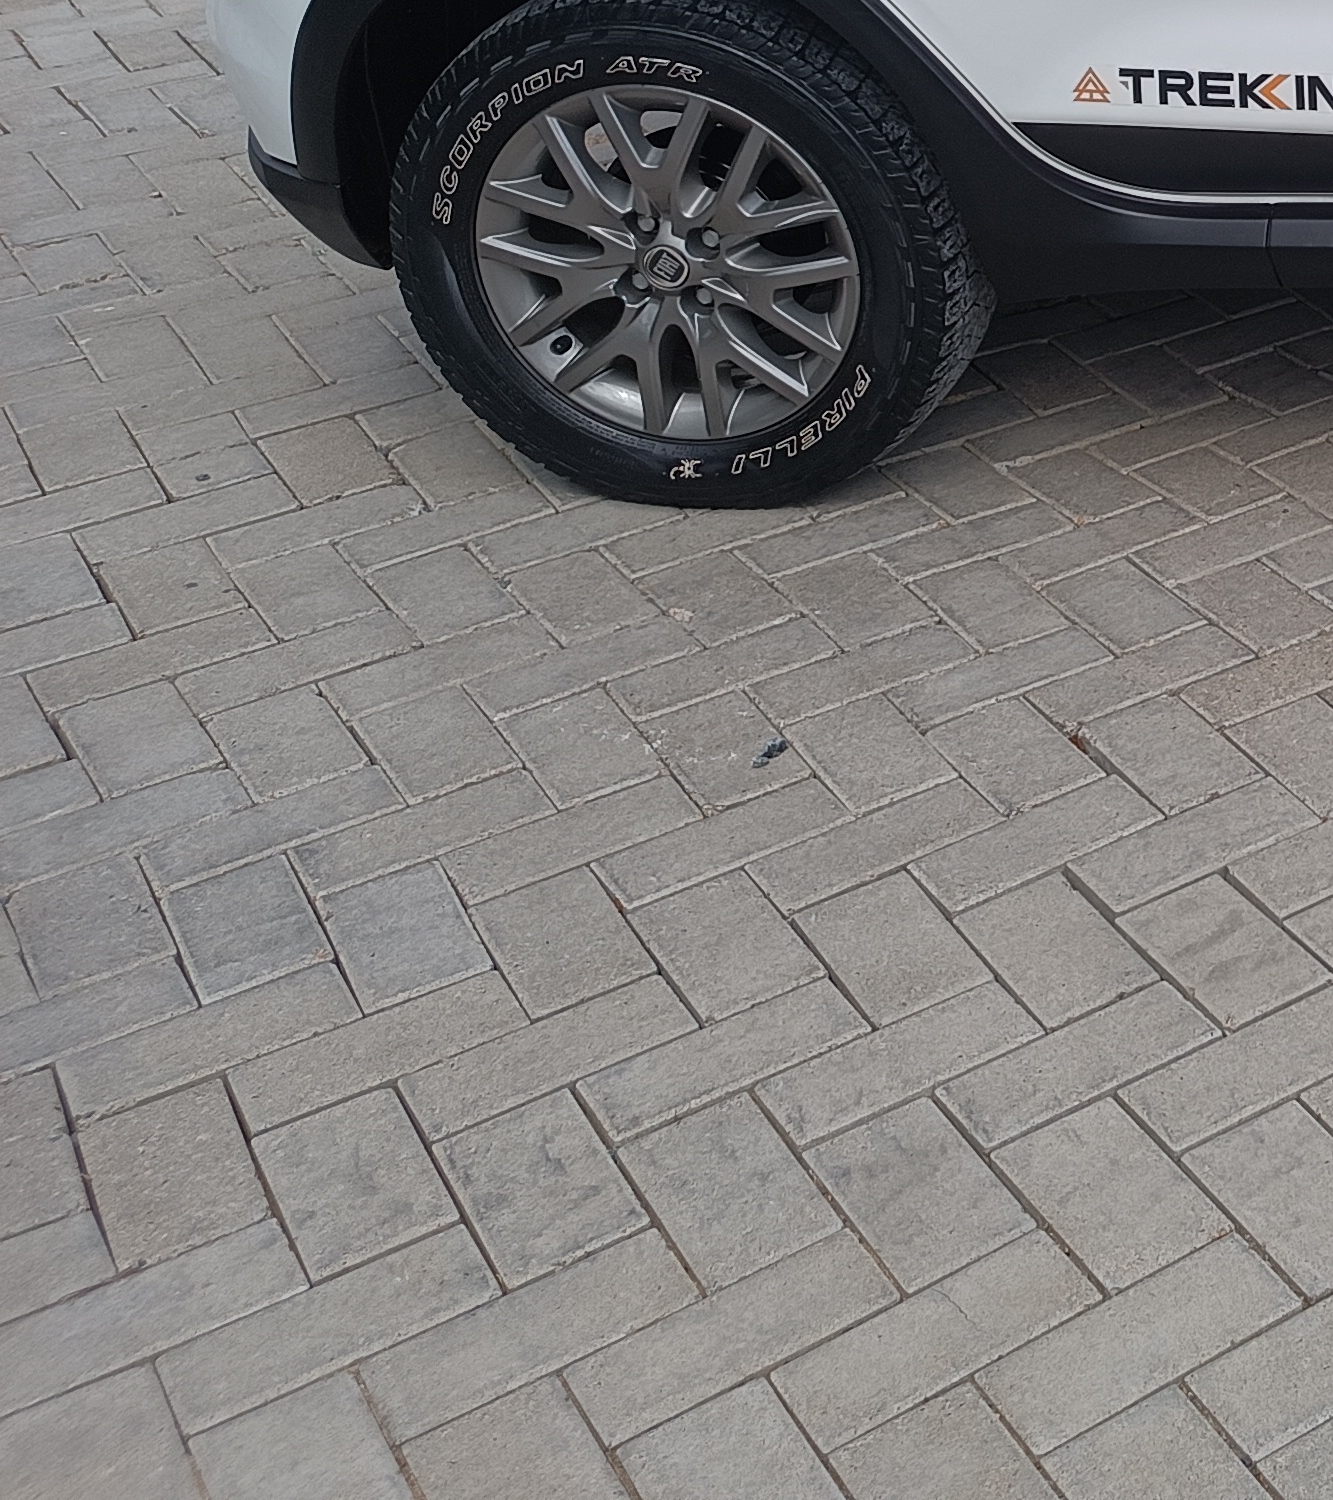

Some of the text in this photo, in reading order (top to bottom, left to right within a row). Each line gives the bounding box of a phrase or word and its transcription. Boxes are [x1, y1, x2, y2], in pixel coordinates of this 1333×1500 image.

[431, 55, 706, 226] SCORPION ATR
[652, 252, 681, 281] FIAT
[731, 364, 872, 475] PIRELLI
